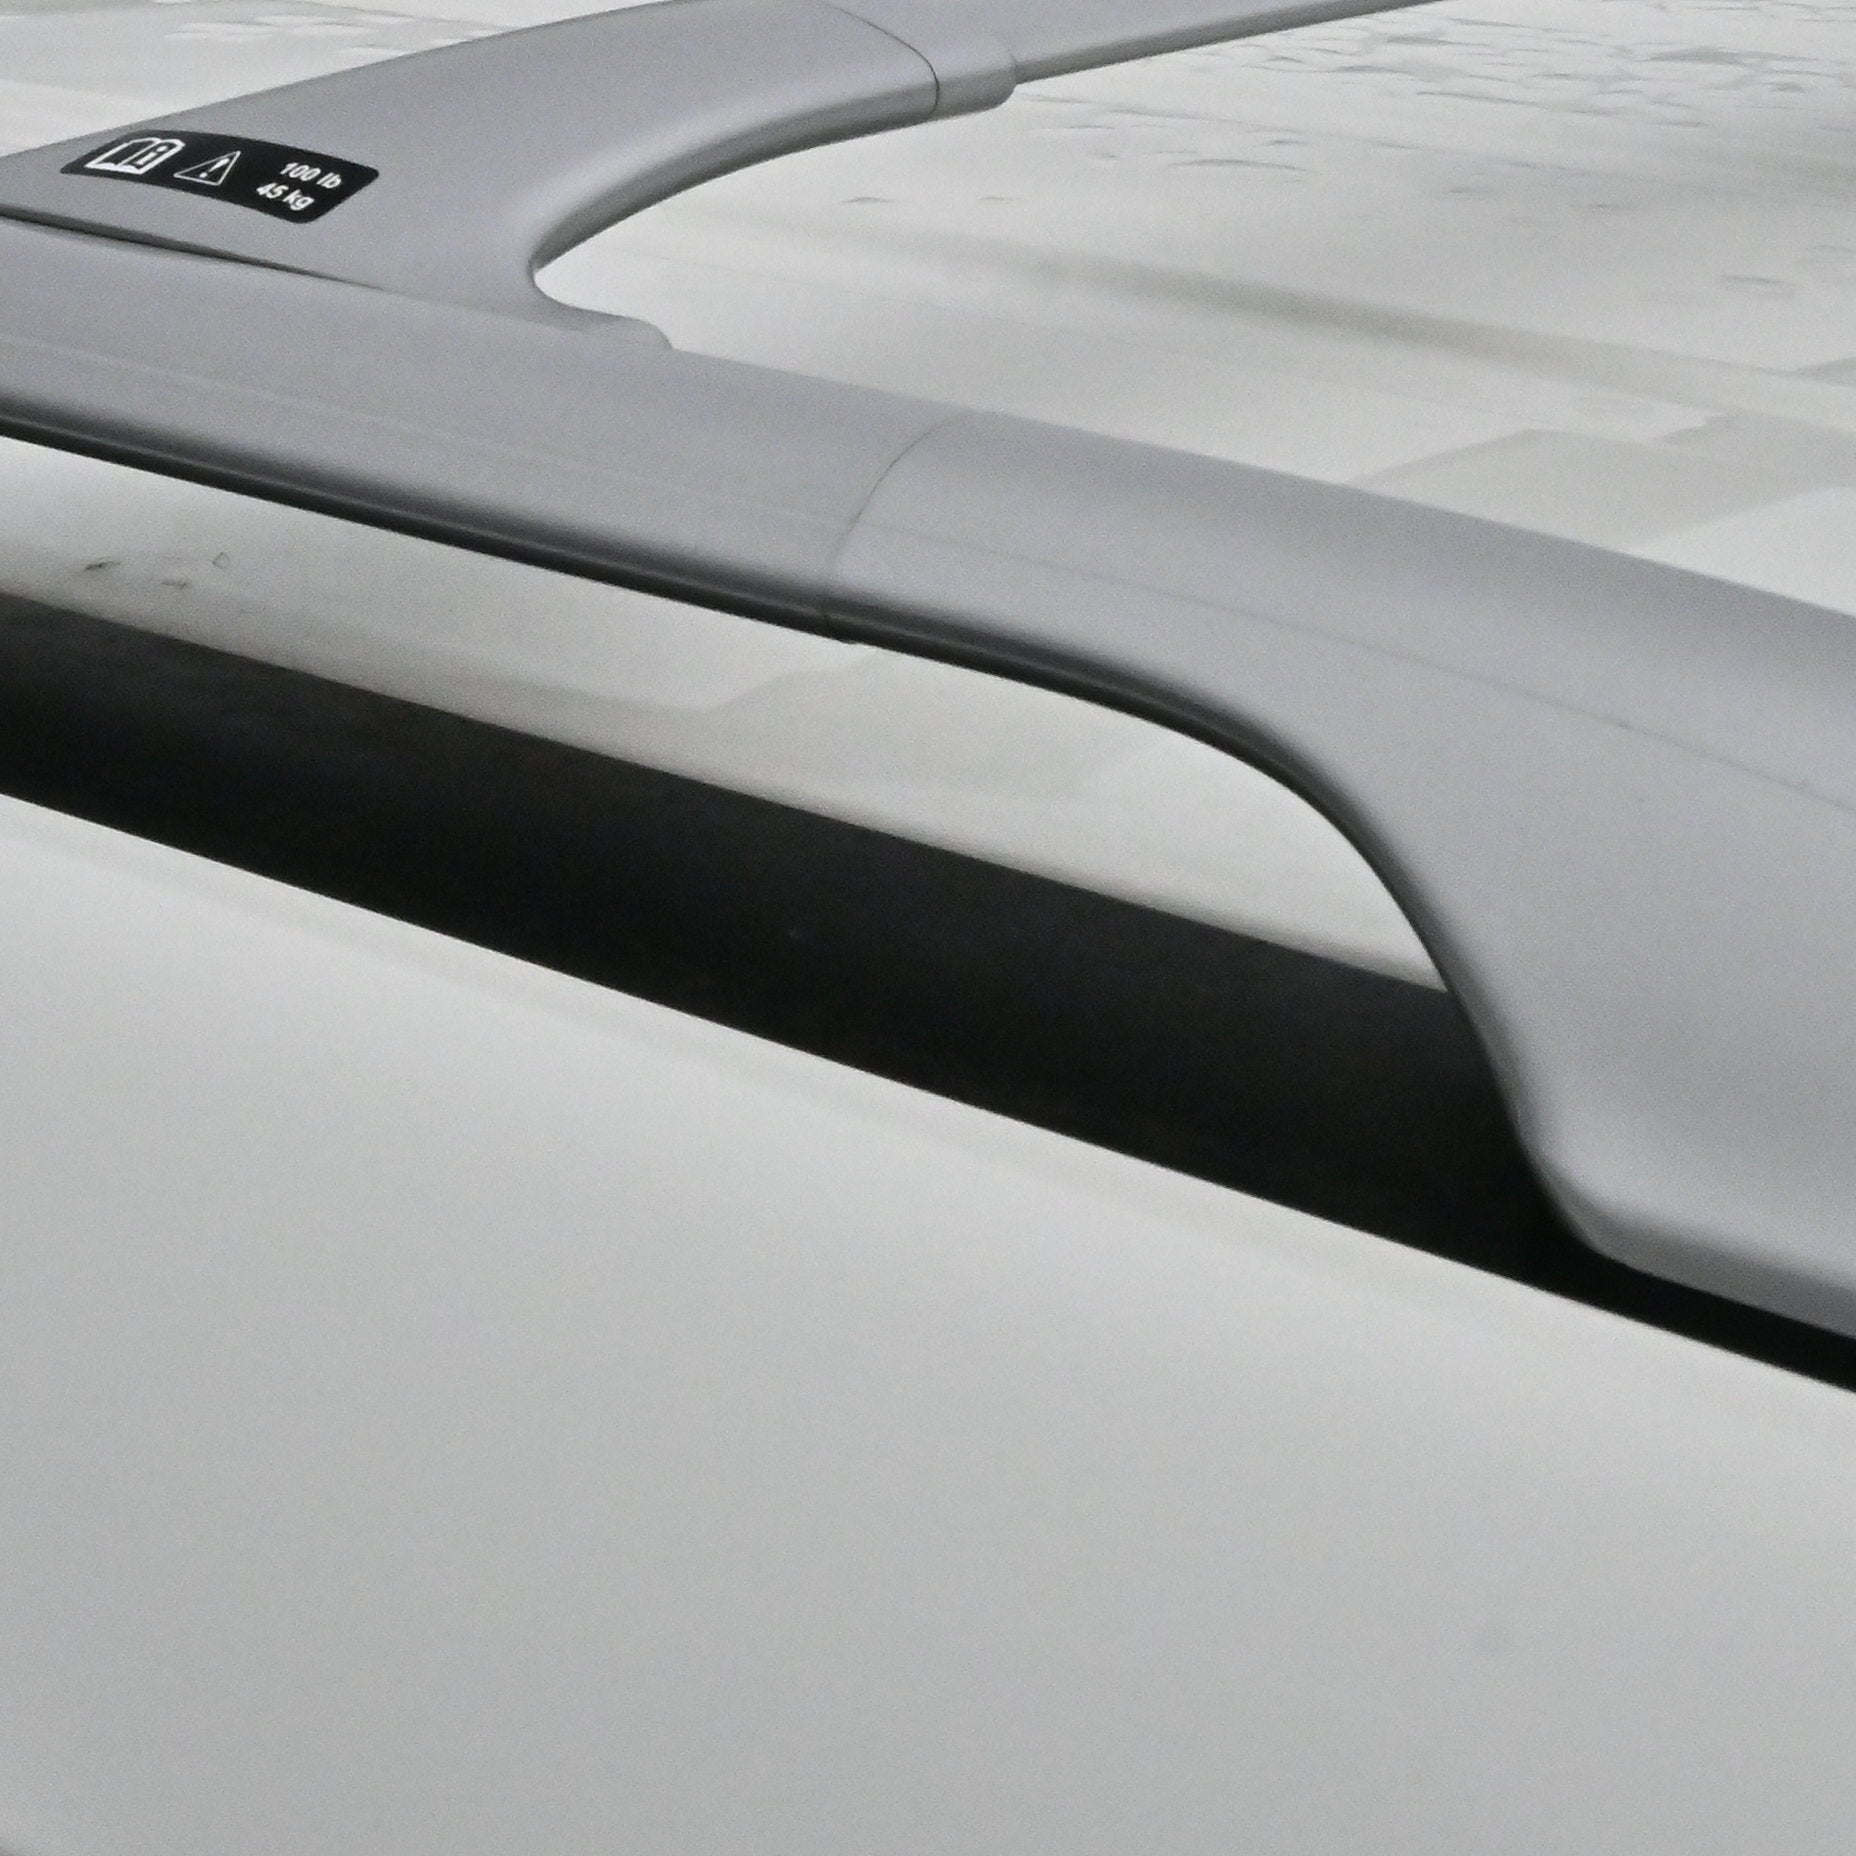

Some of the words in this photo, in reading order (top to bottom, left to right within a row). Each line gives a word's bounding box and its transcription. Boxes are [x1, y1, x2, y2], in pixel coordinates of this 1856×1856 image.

[279, 161, 321, 182] 100
[318, 172, 343, 190] lb
[256, 182, 284, 199] 45
[285, 189, 315, 212] kg
